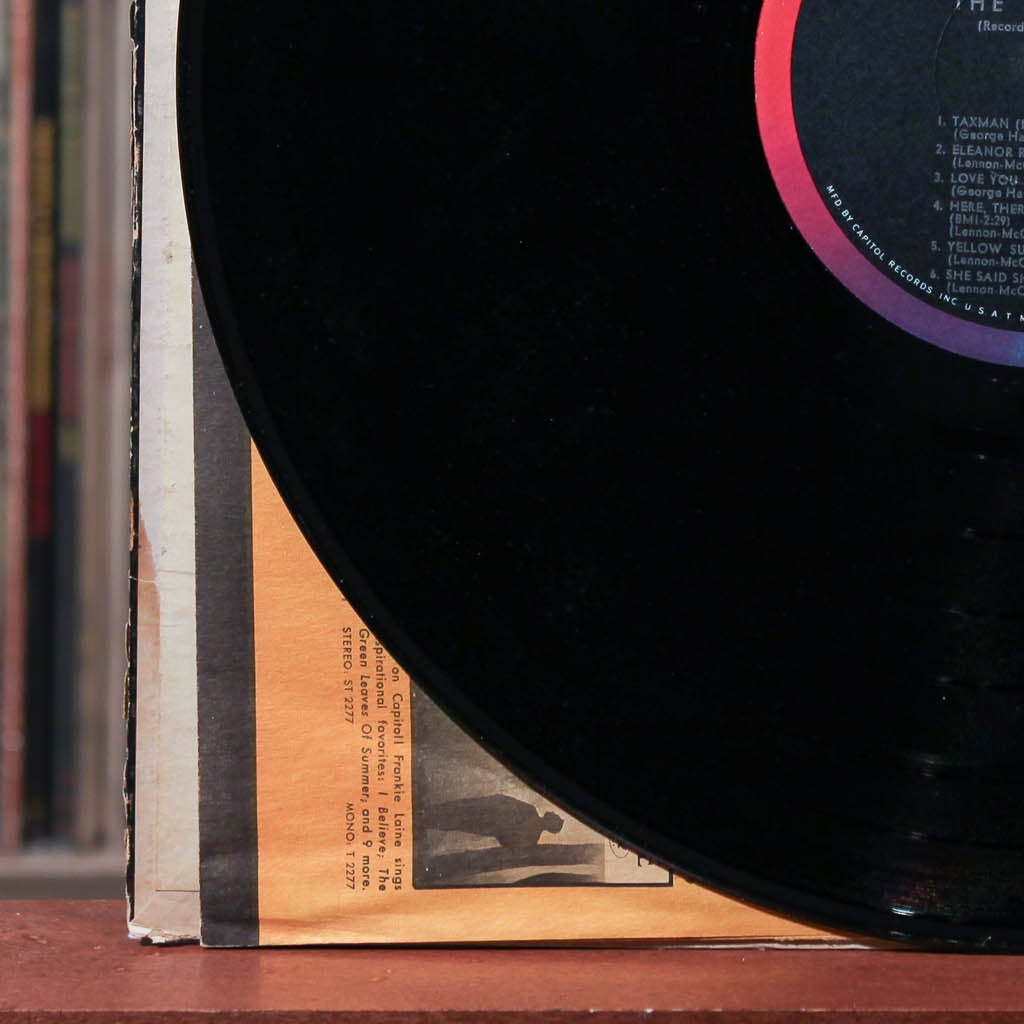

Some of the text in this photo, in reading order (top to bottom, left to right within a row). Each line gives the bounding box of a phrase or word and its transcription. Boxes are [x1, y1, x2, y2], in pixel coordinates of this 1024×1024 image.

[952, 116, 1009, 128] TAXMAN
[954, 128, 1001, 142] (George
[935, 144, 946, 155] 2.
[952, 144, 1013, 157] ELEANOR
[951, 173, 984, 184] LOVE
[989, 173, 1018, 186] YOU
[951, 186, 1001, 200] (George
[932, 201, 943, 212] 4.
[950, 201, 987, 214] HERE,
[841, 209, 854, 223] BY
[852, 223, 886, 261] CAPITOL
[888, 259, 933, 294] RECORDS
[930, 241, 941, 251] 5.
[948, 242, 1001, 254] YELLOW
[946, 270, 973, 281] SHE
[976, 270, 1007, 283] SAID
[359, 628, 370, 667] Green
[392, 667, 399, 682] on
[344, 680, 353, 692] ST
[360, 675, 371, 716] Leaves
[344, 697, 354, 725] 2277
[361, 723, 372, 739] Of
[394, 755, 404, 802] Frankie
[362, 808, 373, 832] and
[394, 814, 405, 847] Laine
[346, 863, 355, 890] 2277
[362, 855, 370, 891] more.
[378, 868, 389, 891] The
[392, 857, 405, 890] sings
